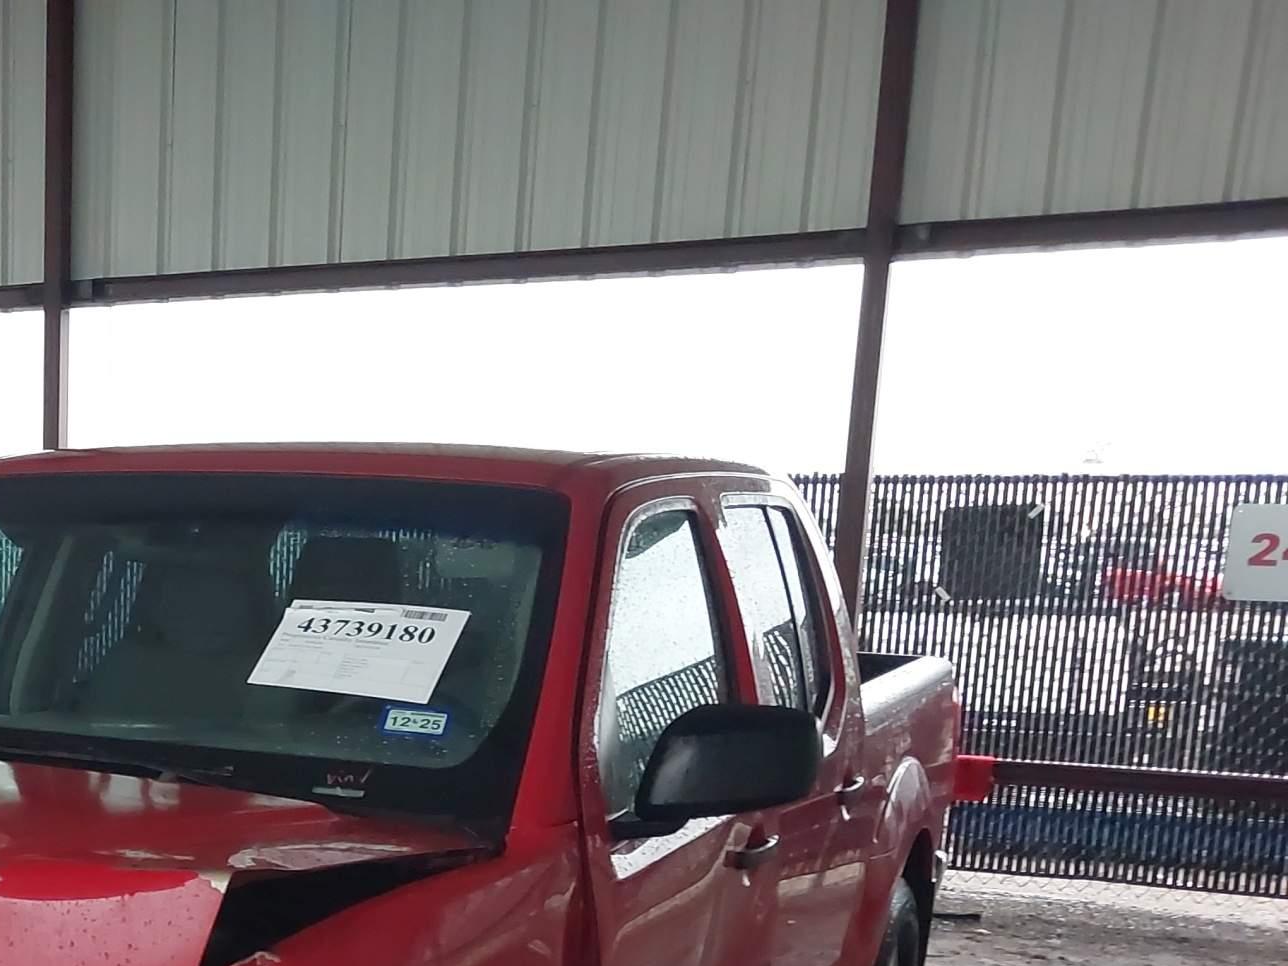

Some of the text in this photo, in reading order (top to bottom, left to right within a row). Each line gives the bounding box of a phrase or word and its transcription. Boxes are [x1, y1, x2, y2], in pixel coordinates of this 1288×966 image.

[1247, 532, 1288, 567] 2
[297, 616, 436, 645] 43739180
[390, 716, 443, 731] 12 25
